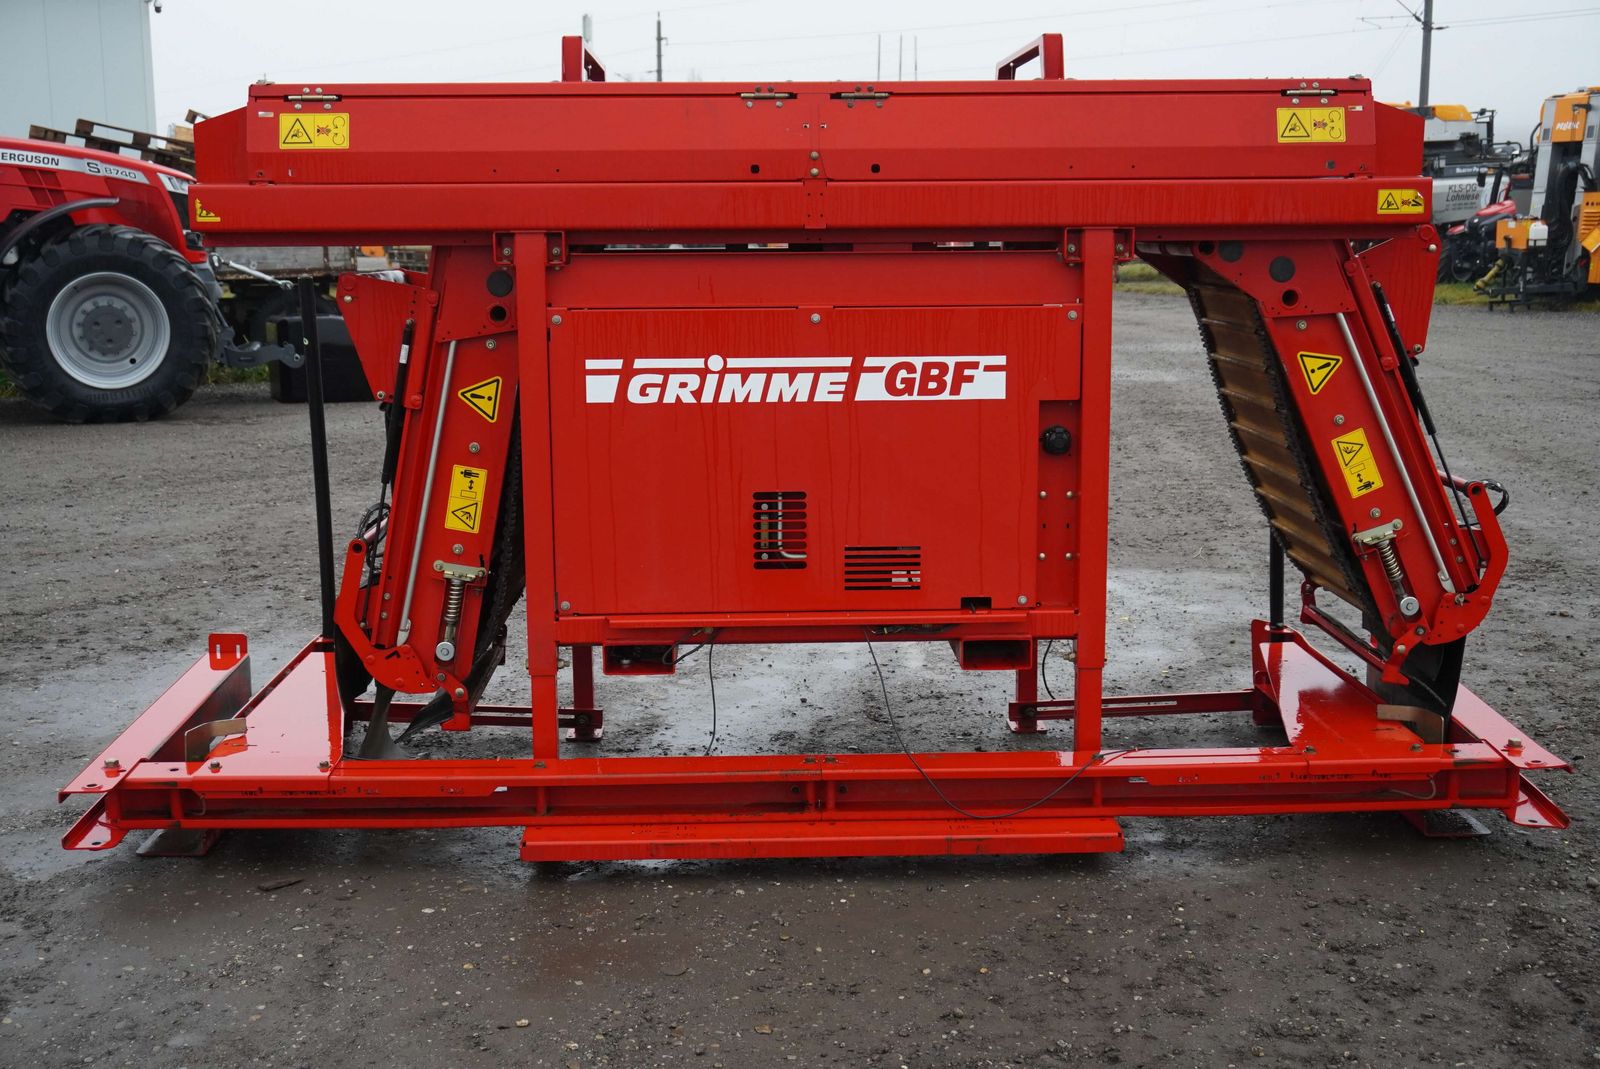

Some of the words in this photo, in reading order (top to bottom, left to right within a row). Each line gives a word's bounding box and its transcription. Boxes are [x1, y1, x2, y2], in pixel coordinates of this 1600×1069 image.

[86, 161, 101, 174] S
[104, 166, 137, 179] 8740
[884, 360, 980, 397] GBF
